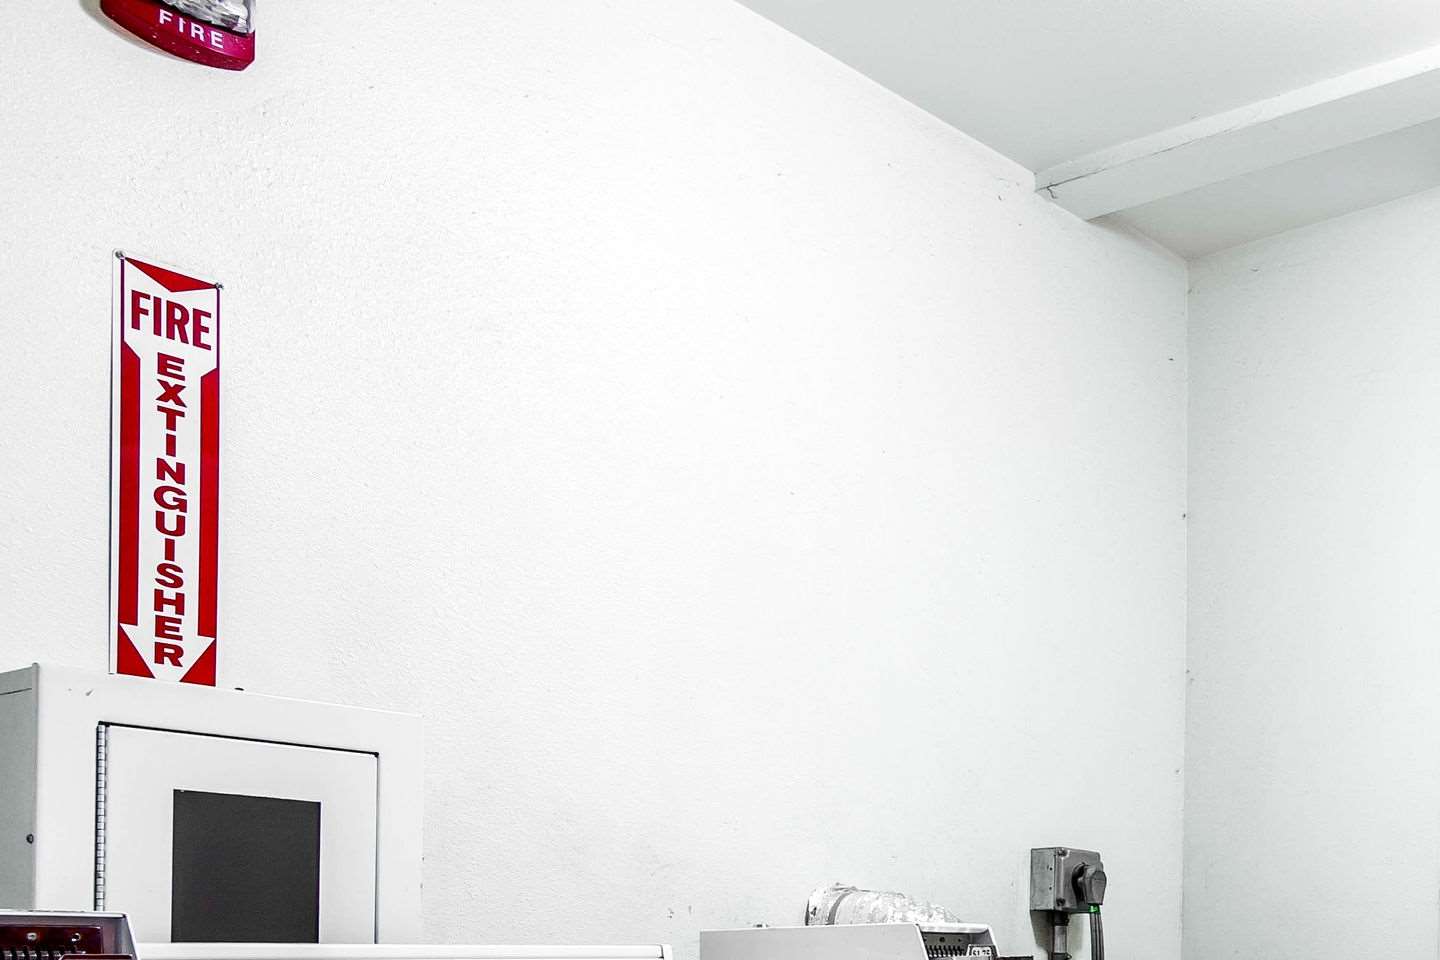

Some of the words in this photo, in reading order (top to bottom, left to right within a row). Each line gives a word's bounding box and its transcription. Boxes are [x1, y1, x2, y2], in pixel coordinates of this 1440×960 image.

[160, 9, 223, 48] FIRE
[130, 290, 212, 351] FIRE
[153, 352, 187, 667] EXTINGUISHER
